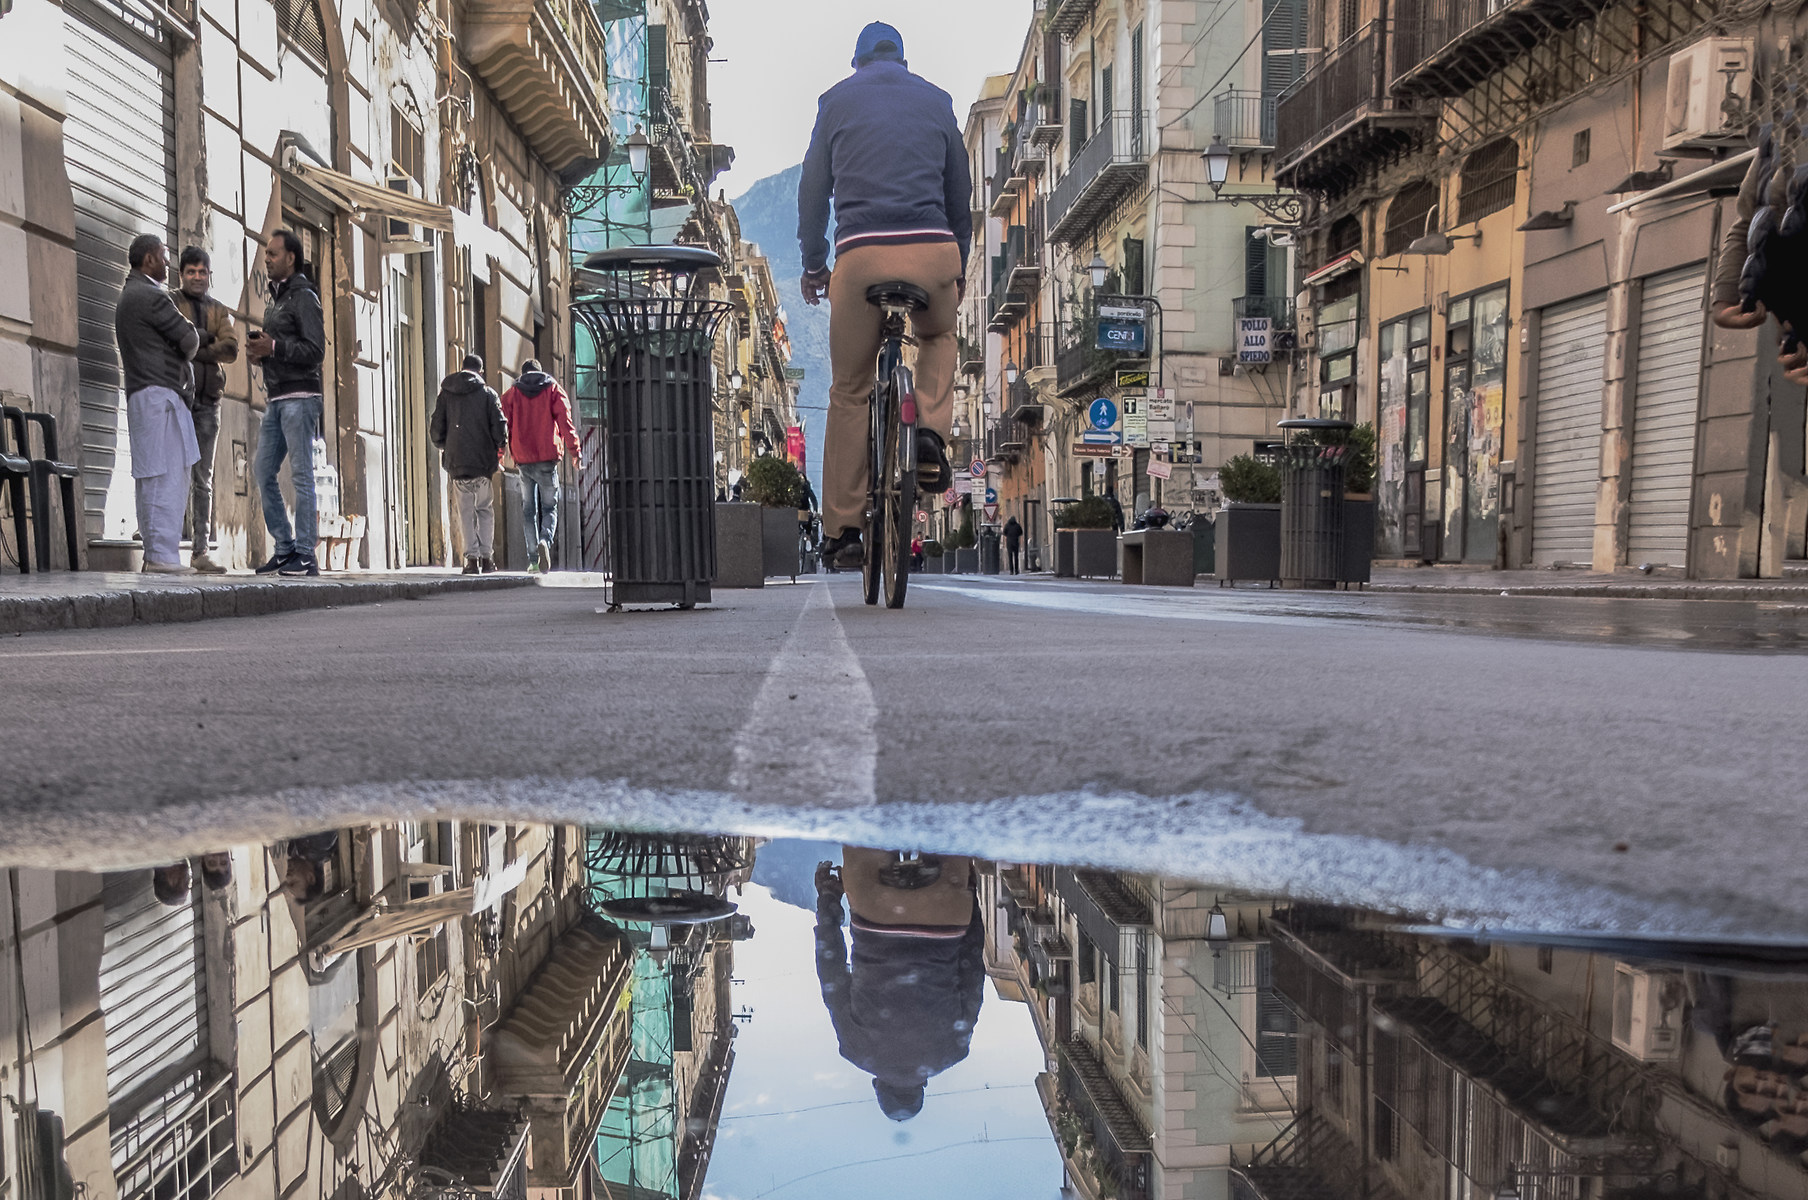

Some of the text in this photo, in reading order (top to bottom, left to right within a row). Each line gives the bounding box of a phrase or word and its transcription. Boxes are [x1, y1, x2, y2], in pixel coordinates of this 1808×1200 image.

[1241, 320, 1268, 331] POLLO
[1244, 335, 1266, 346] ALLO
[1240, 351, 1270, 361] SPIEDO
[1125, 399, 1135, 413] T
[1169, 444, 1181, 463] T
